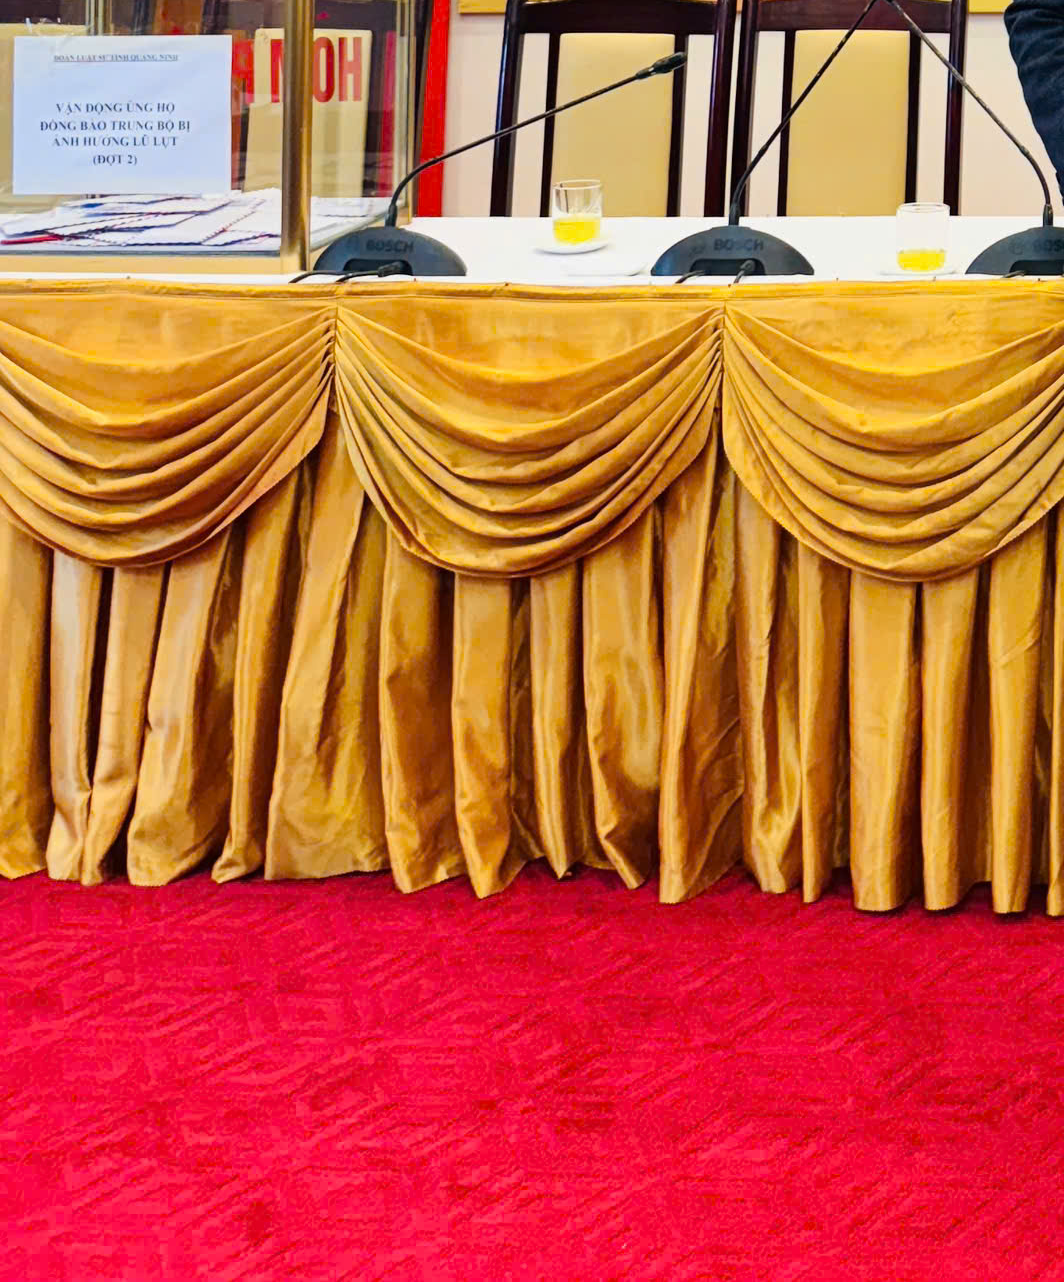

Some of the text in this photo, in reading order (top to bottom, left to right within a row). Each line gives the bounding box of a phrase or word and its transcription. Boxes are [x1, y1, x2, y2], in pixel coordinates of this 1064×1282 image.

[56, 101, 82, 116] VẬN
[85, 101, 123, 115] ĐỘNG
[157, 101, 176, 115] HỘ
[111, 120, 154, 132] TRUNG
[157, 119, 175, 134] BỘ
[178, 120, 191, 134] BỊ
[133, 133, 150, 147] LŨ
[153, 136, 179, 149] LỤT
[92, 154, 138, 166] (ĐỢT 2)
[366, 239, 415, 252] BOSCH
[714, 238, 764, 251] BOSCH
